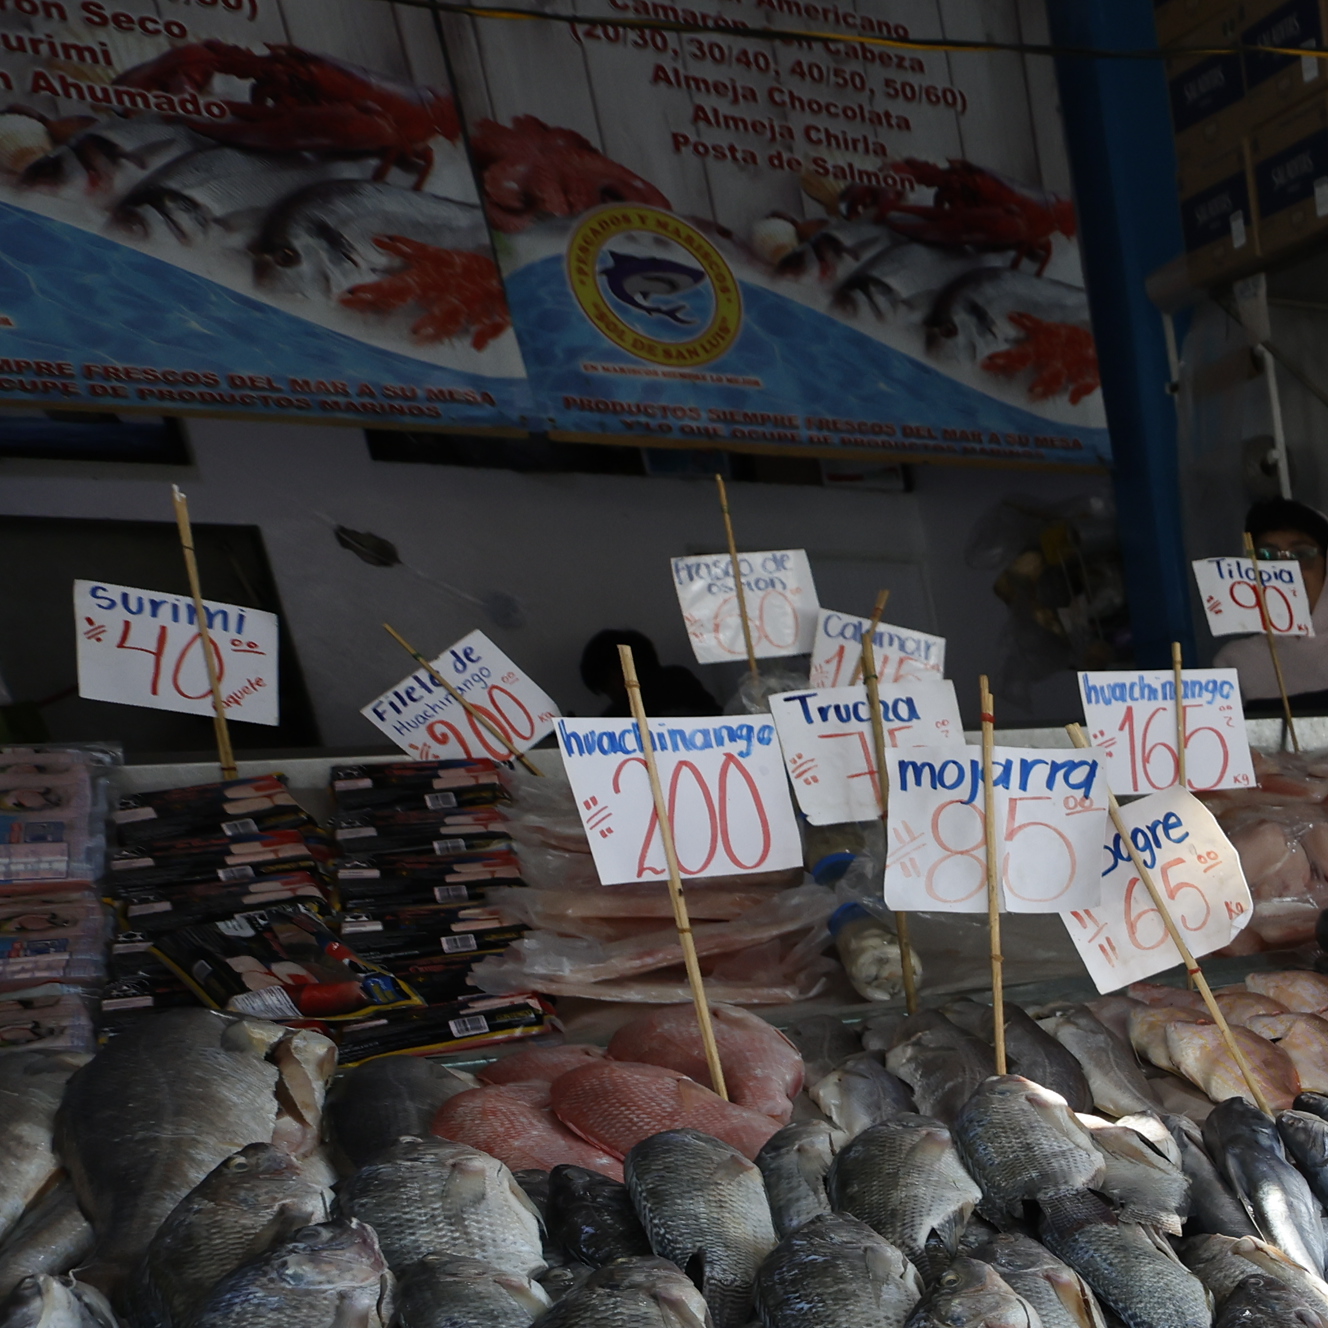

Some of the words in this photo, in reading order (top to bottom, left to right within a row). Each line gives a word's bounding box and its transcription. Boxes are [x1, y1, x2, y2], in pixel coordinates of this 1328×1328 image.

[82, 2, 188, 39] Seco
[31, 71, 229, 120] Ahumado
[651, 64, 758, 106] Almeja
[768, 85, 912, 131] Chocolata
[689, 37, 781, 79] 30/40,
[790, 59, 876, 98] 40/50,
[884, 78, 968, 114] 50/60)
[691, 105, 795, 143] Almeja
[804, 125, 889, 158] Chirla
[670, 132, 758, 166] Posta
[768, 155, 803, 173] de
[812, 157, 918, 192] Salmón
[83, 362, 221, 389] FRESCOS
[226, 372, 284, 393] DEL
[289, 377, 350, 399] MAR
[357, 382, 377, 400] A
[381, 384, 419, 403] SU
[424, 385, 497, 408] MESA
[90, 382, 129, 399] DE
[138, 386, 313, 410] PRODUCTOS
[562, 395, 702, 421] PRODUCTOS
[708, 408, 799, 430] SIEMPRE
[804, 416, 897, 437] FRESCOS
[902, 424, 938, 441] DEL
[942, 427, 983, 445] MAR
[1034, 434, 1084, 450] MESA
[761, 553, 790, 575] de
[1229, 580, 1294, 633] 90
[115, 619, 225, 701] 40
[372, 668, 445, 723] Filete
[450, 645, 483, 675] de
[1082, 674, 1234, 706] huachinango
[425, 684, 536, 761] 200
[557, 718, 776, 760] huachinango
[1118, 703, 1230, 795] 165
[898, 757, 1100, 806] mojarra
[611, 752, 773, 879] 200
[924, 796, 1078, 904] 85
[1124, 855, 1212, 951] 65
